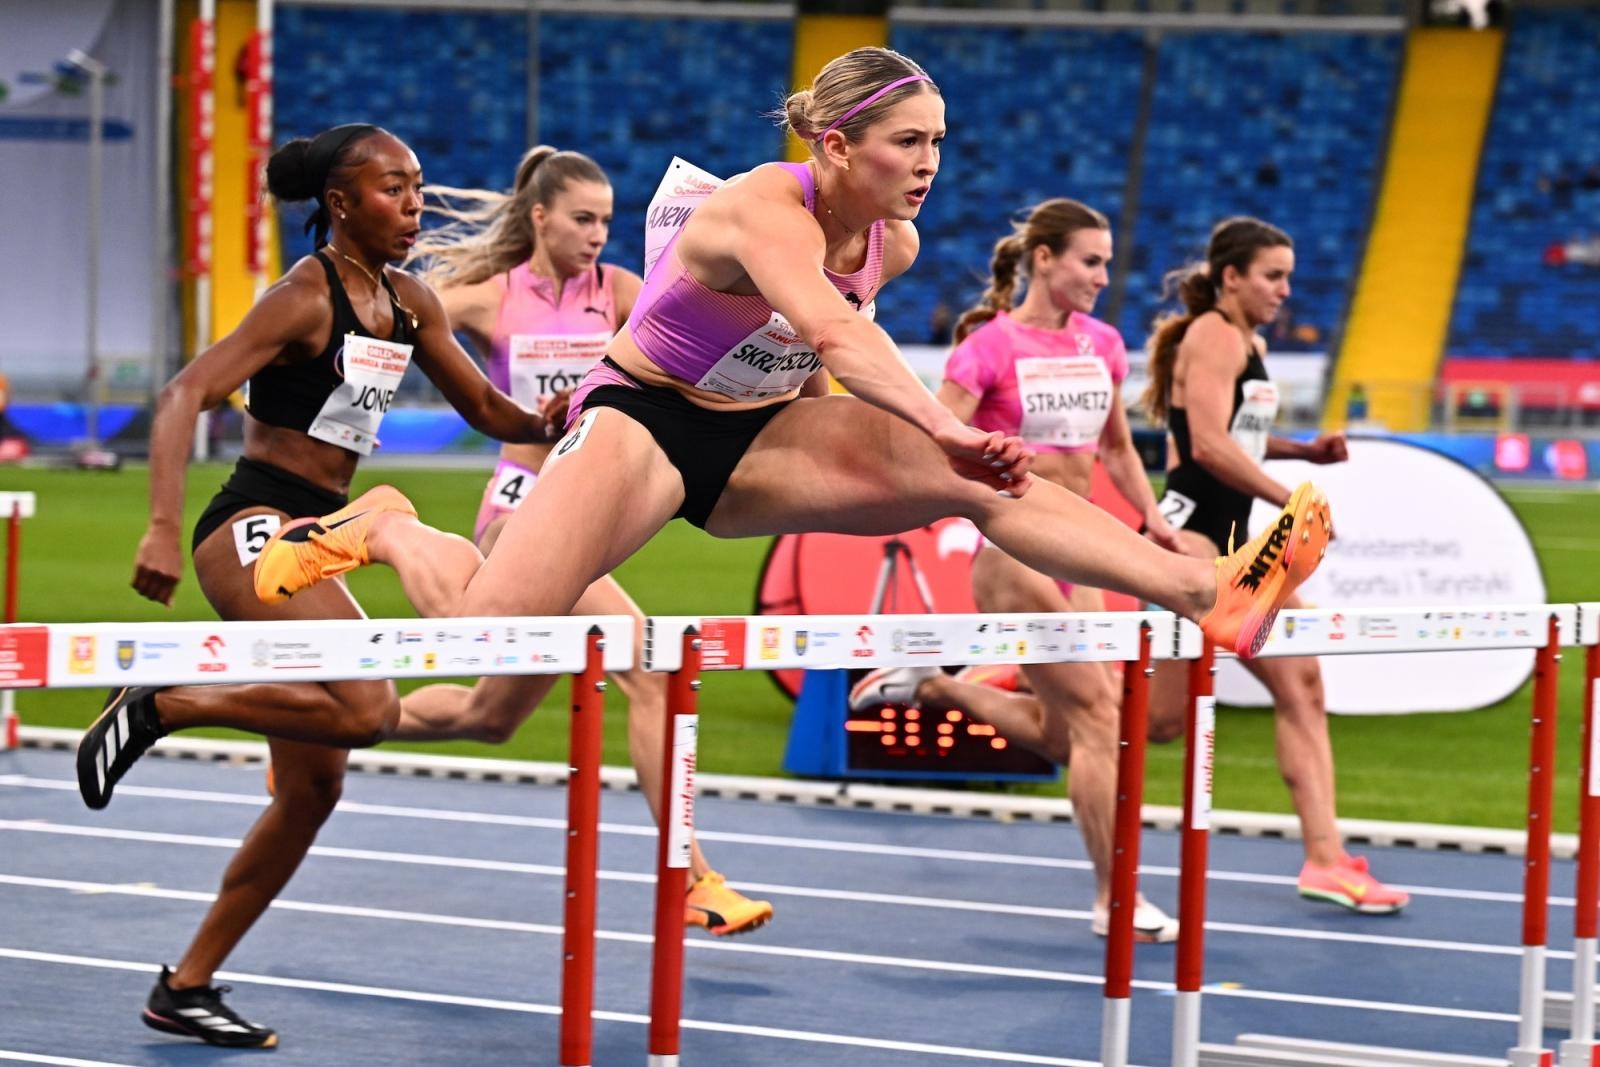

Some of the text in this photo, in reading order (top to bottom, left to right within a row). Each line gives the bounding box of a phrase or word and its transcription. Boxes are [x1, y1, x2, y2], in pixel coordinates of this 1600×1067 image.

[536, 369, 585, 395] TÓT
[1026, 390, 1108, 413] STRAMETZ
[500, 475, 525, 504] 4
[1164, 498, 1185, 525] 2
[246, 518, 271, 554] 5
[1234, 513, 1295, 596] NITRO
